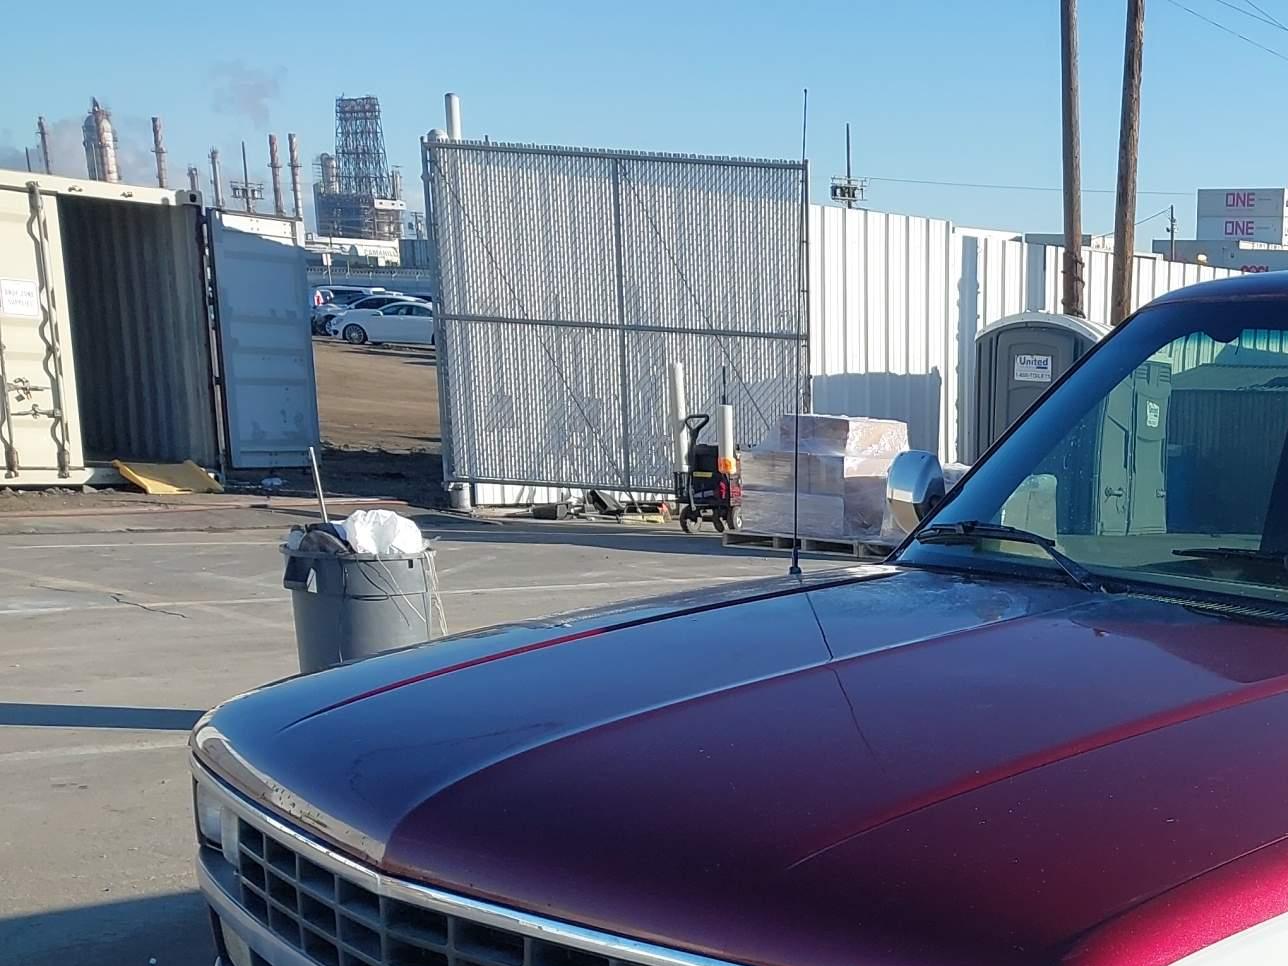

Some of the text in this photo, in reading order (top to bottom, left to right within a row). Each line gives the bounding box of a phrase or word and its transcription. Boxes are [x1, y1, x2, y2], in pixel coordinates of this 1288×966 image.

[1225, 192, 1256, 208] ONE
[1224, 221, 1255, 236] ONE
[1019, 356, 1049, 366] United
